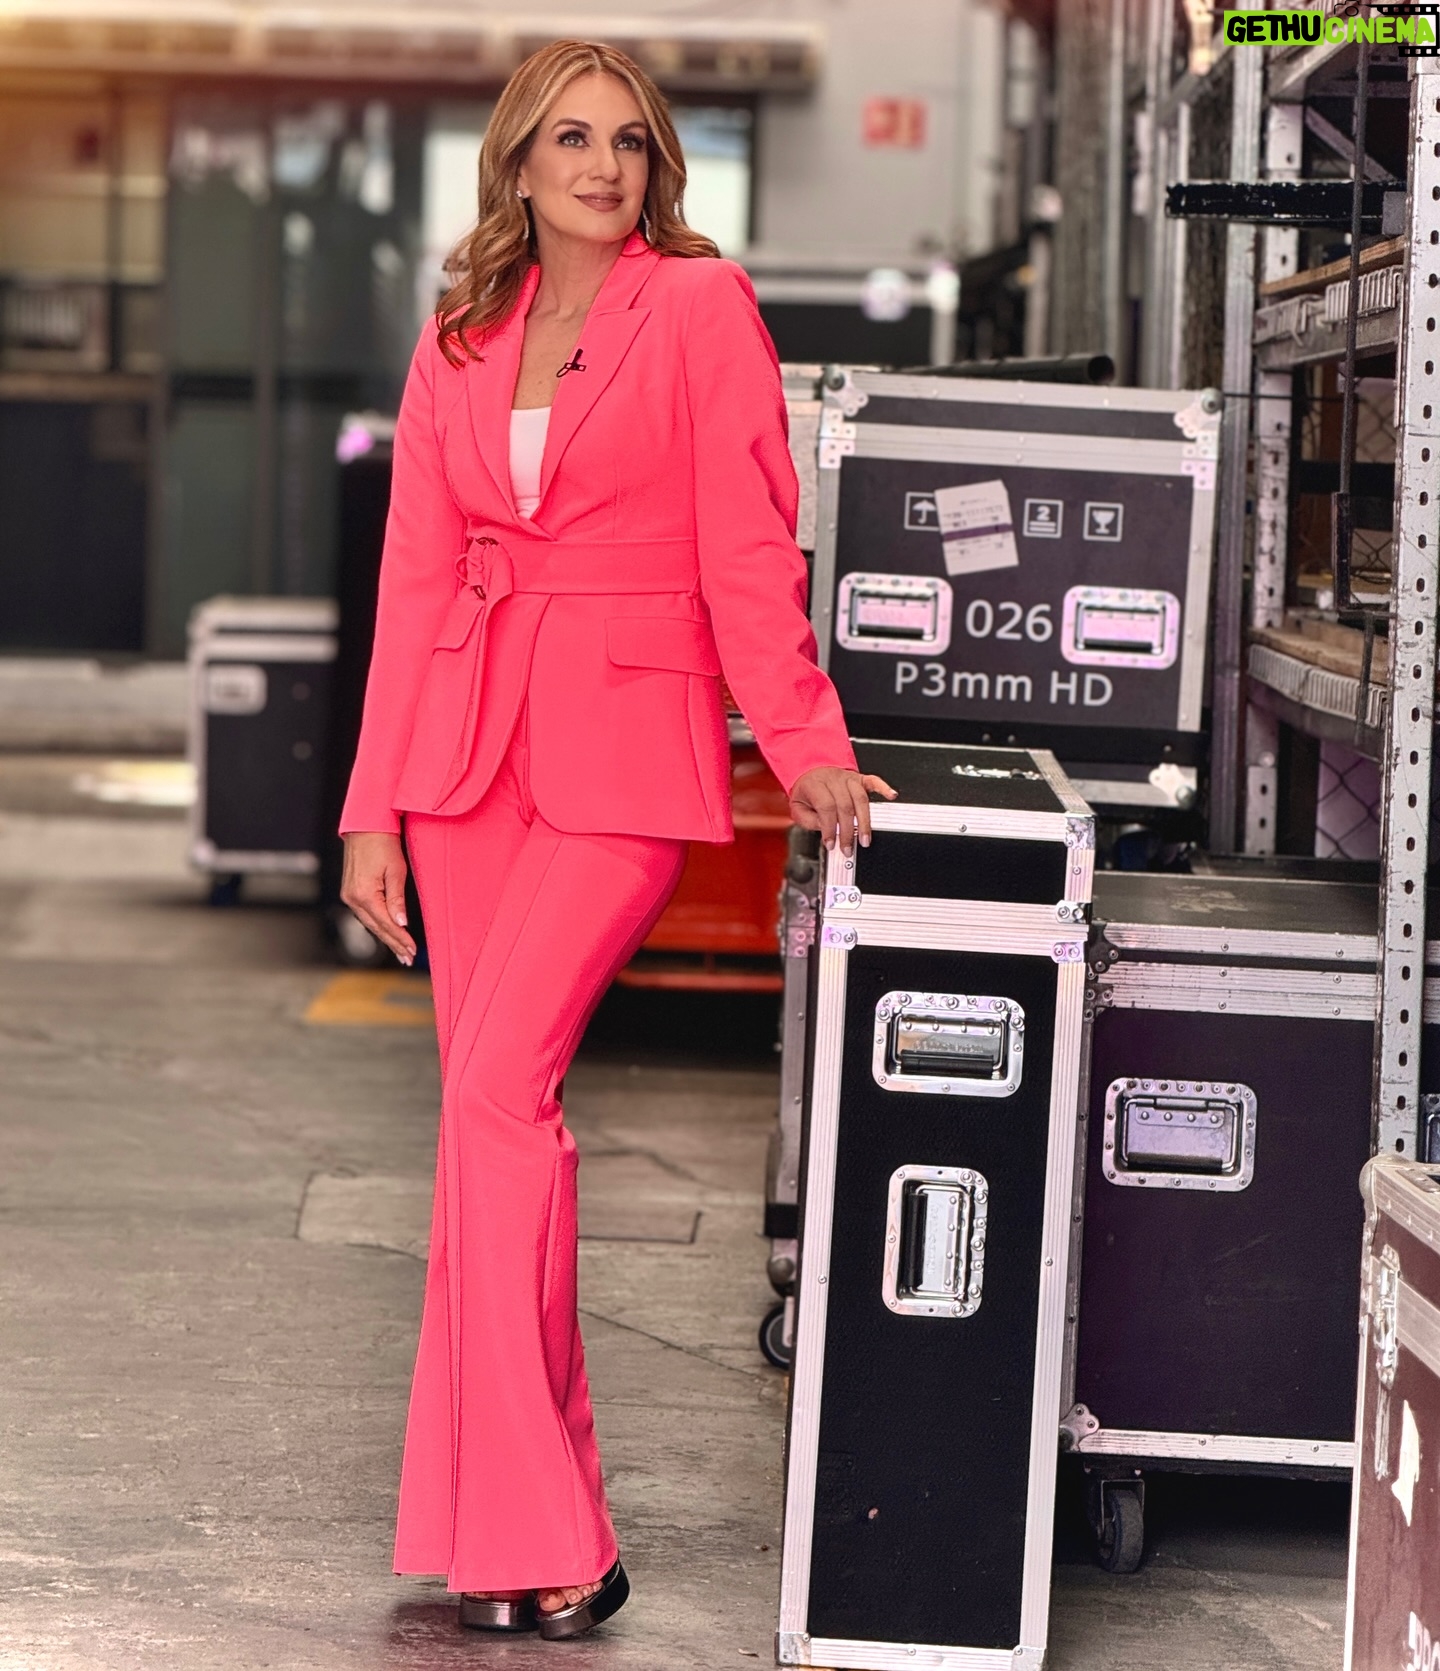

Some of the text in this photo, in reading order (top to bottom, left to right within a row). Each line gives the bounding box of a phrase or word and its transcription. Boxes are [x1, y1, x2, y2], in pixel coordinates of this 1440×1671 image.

[1036, 505, 1050, 521] 2
[965, 598, 1054, 643] 026
[894, 660, 1114, 707] P3mm HD
